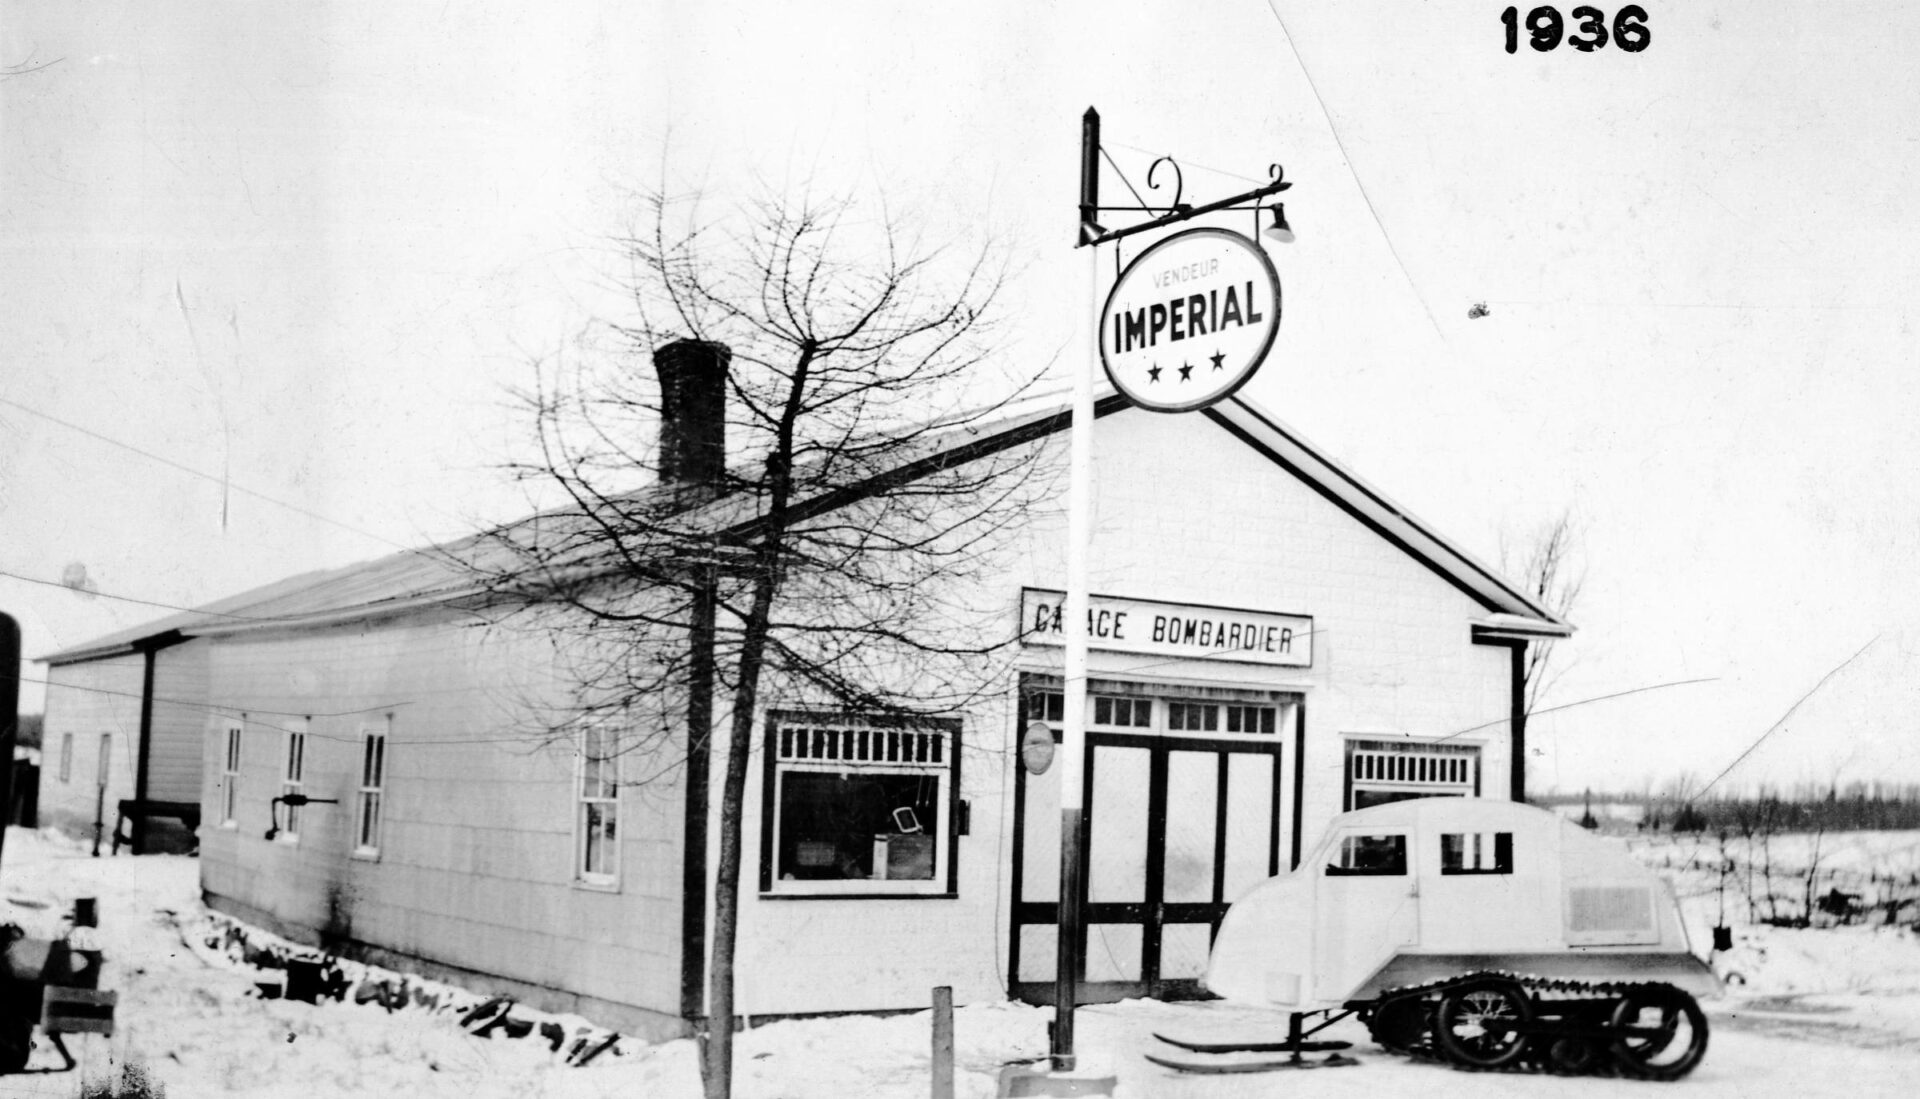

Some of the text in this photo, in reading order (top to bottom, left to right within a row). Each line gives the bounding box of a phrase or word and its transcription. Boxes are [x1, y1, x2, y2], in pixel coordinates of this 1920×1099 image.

[1152, 258, 1218, 289] VENDEUR
[1114, 280, 1263, 354] IMPERIAL
[1035, 603, 1293, 653] GAAGE BOMBARDIER
